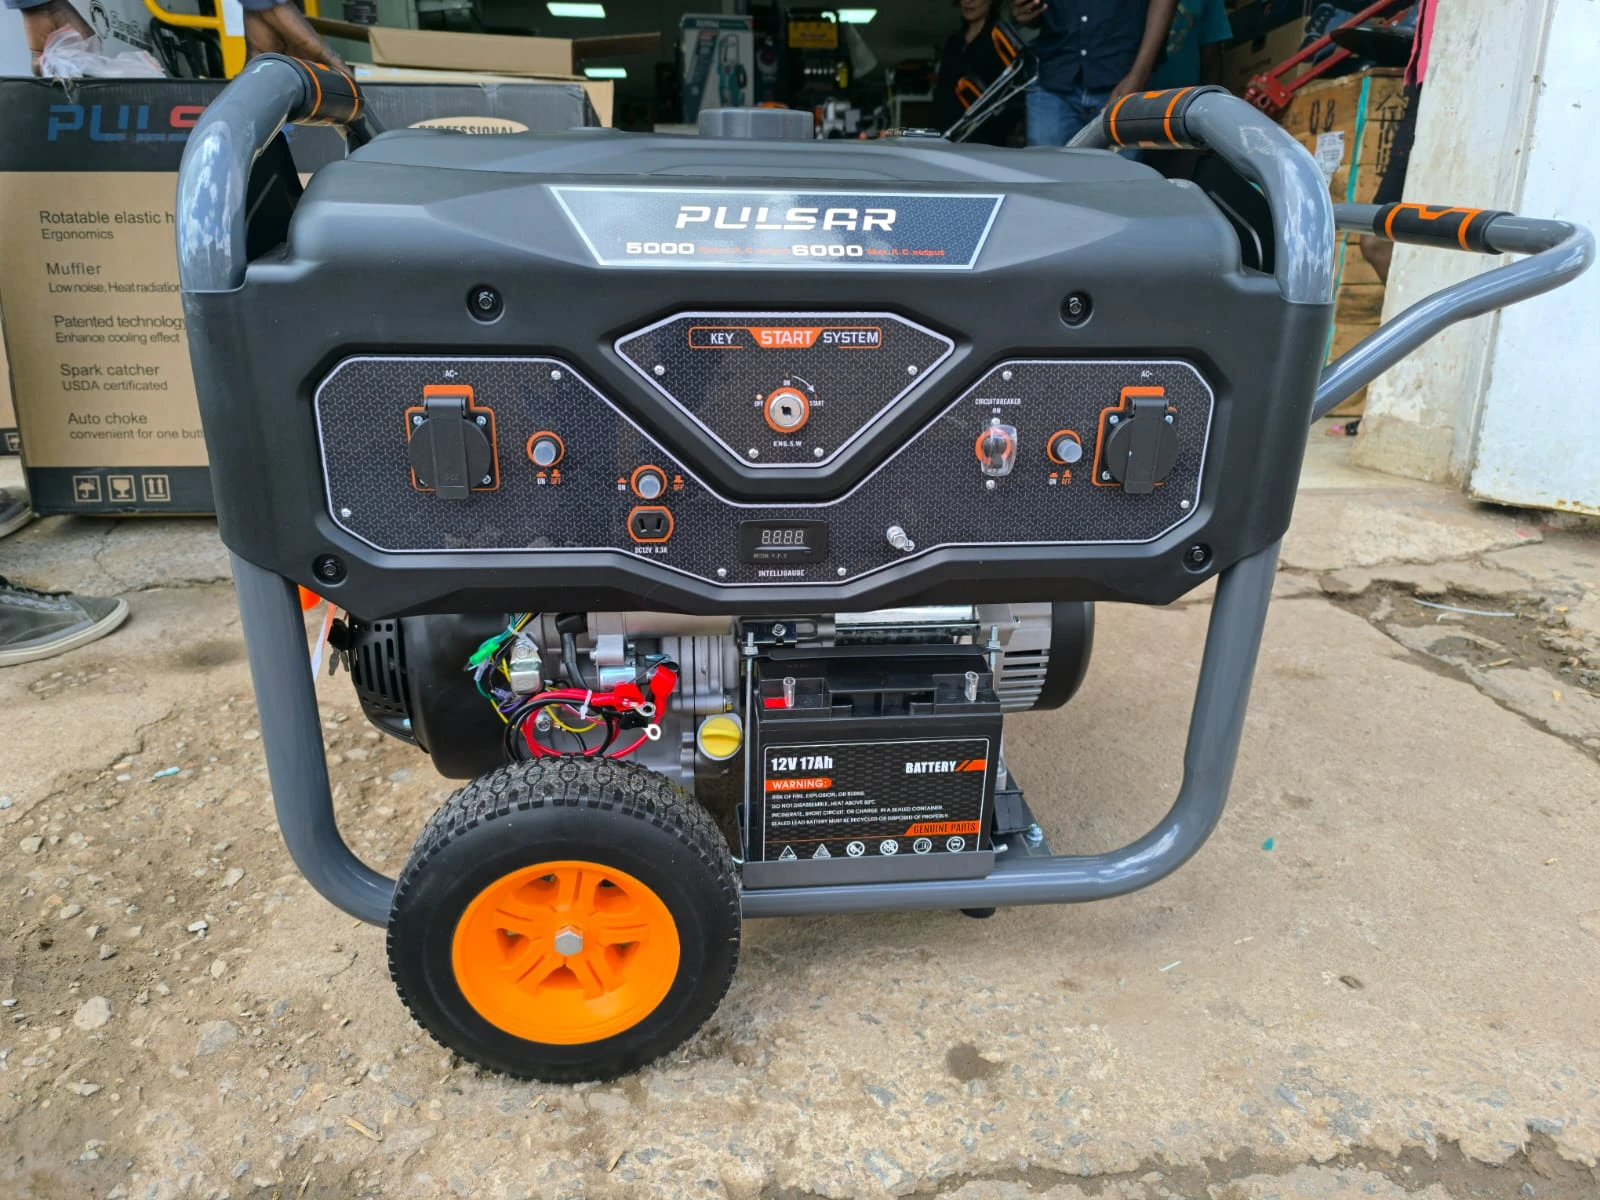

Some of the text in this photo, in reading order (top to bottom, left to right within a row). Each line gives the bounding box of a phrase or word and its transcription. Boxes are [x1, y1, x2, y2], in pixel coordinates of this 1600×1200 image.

[39, 210, 110, 225] Rotatable
[115, 210, 161, 225] elastic
[675, 206, 896, 231] PULSAR
[41, 228, 114, 242] Ergonomics
[626, 242, 695, 255] 5000
[792, 244, 863, 257] 6000
[46, 262, 101, 276] Muffler
[54, 315, 114, 329] Patented
[55, 332, 180, 345] Enhance cooling effect
[711, 330, 879, 346] KEY START SYSTEM
[60, 363, 160, 379] Spark catcher
[62, 380, 168, 391] USDA certificated
[68, 412, 148, 425] Auto choke
[69, 430, 134, 440] convenient
[137, 429, 153, 440] for
[156, 431, 179, 440] one
[771, 755, 833, 771] 12V 17Ah
[905, 761, 957, 774] BATTERY
[773, 779, 827, 790] WARNING:
[914, 822, 976, 835] GENUINE PARTS
